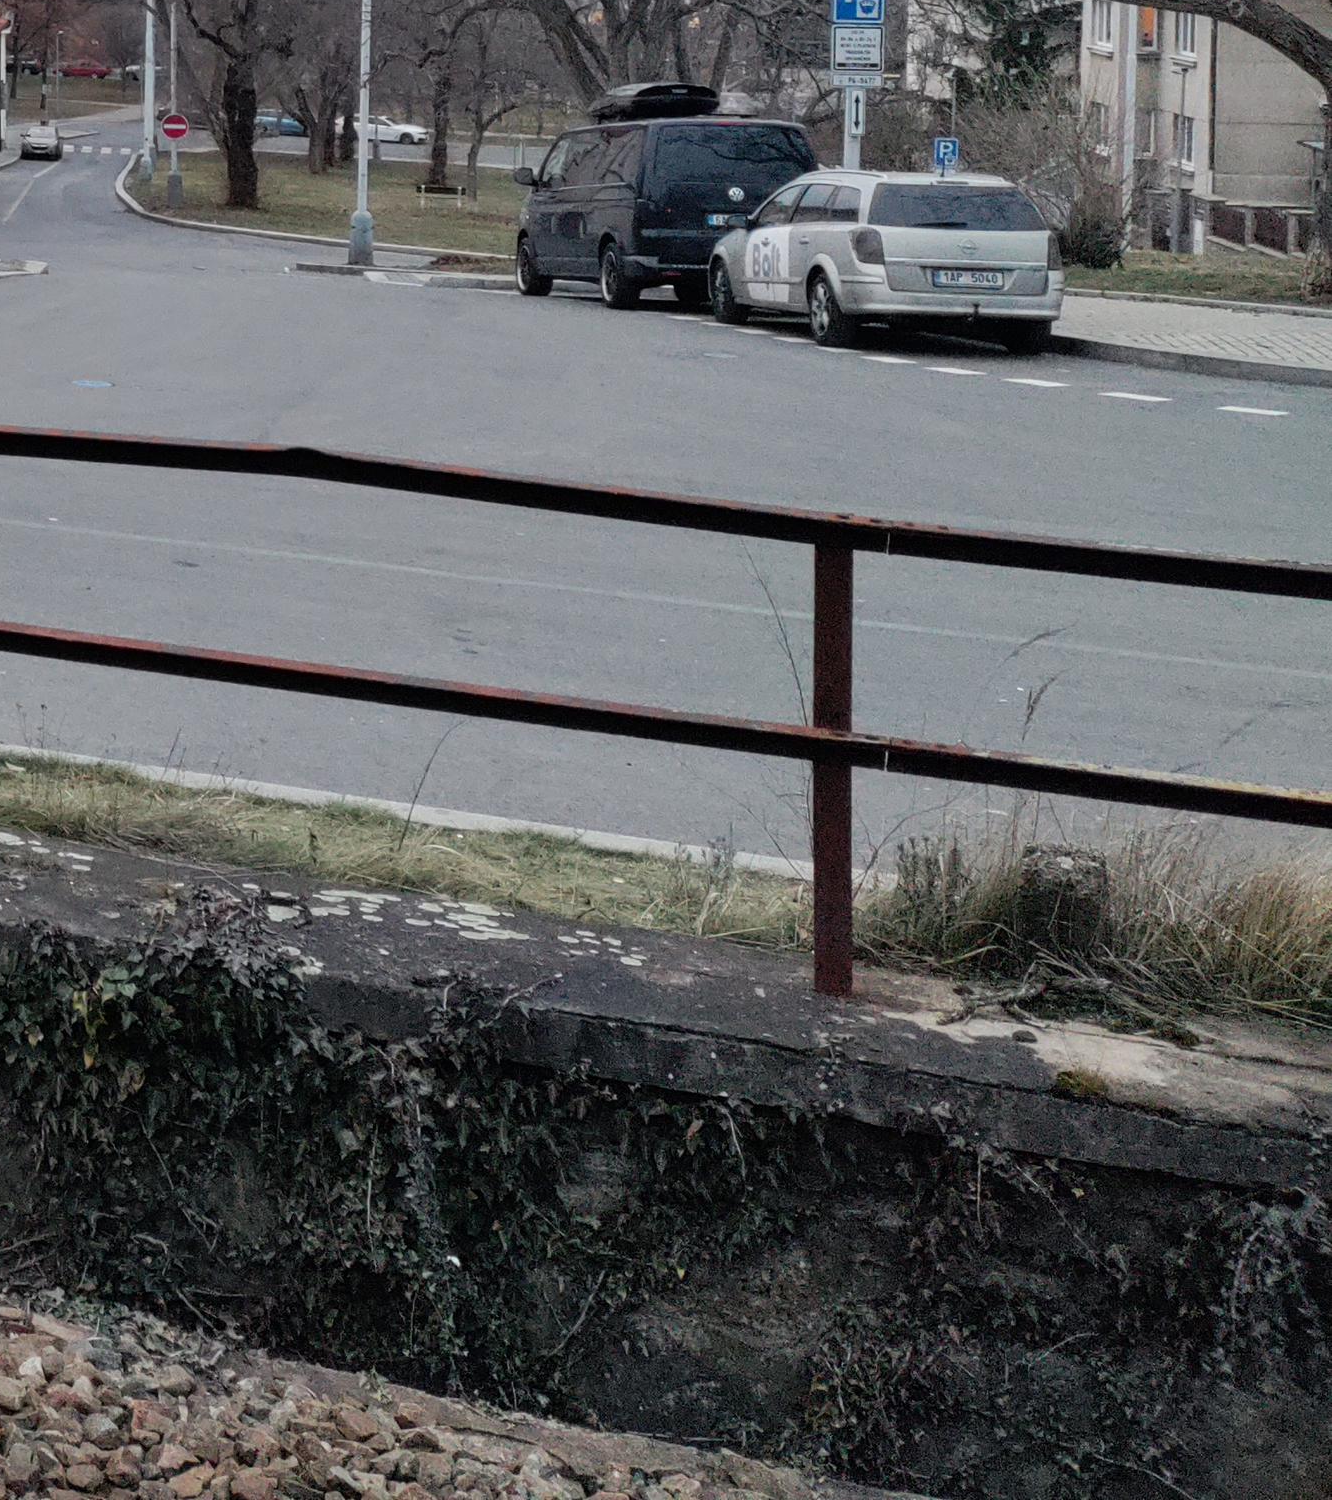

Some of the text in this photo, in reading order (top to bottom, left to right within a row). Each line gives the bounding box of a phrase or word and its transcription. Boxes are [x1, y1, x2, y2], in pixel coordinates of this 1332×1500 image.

[939, 141, 954, 159] P
[752, 243, 781, 278] Bolt
[944, 272, 999, 284] 1AP 5040
